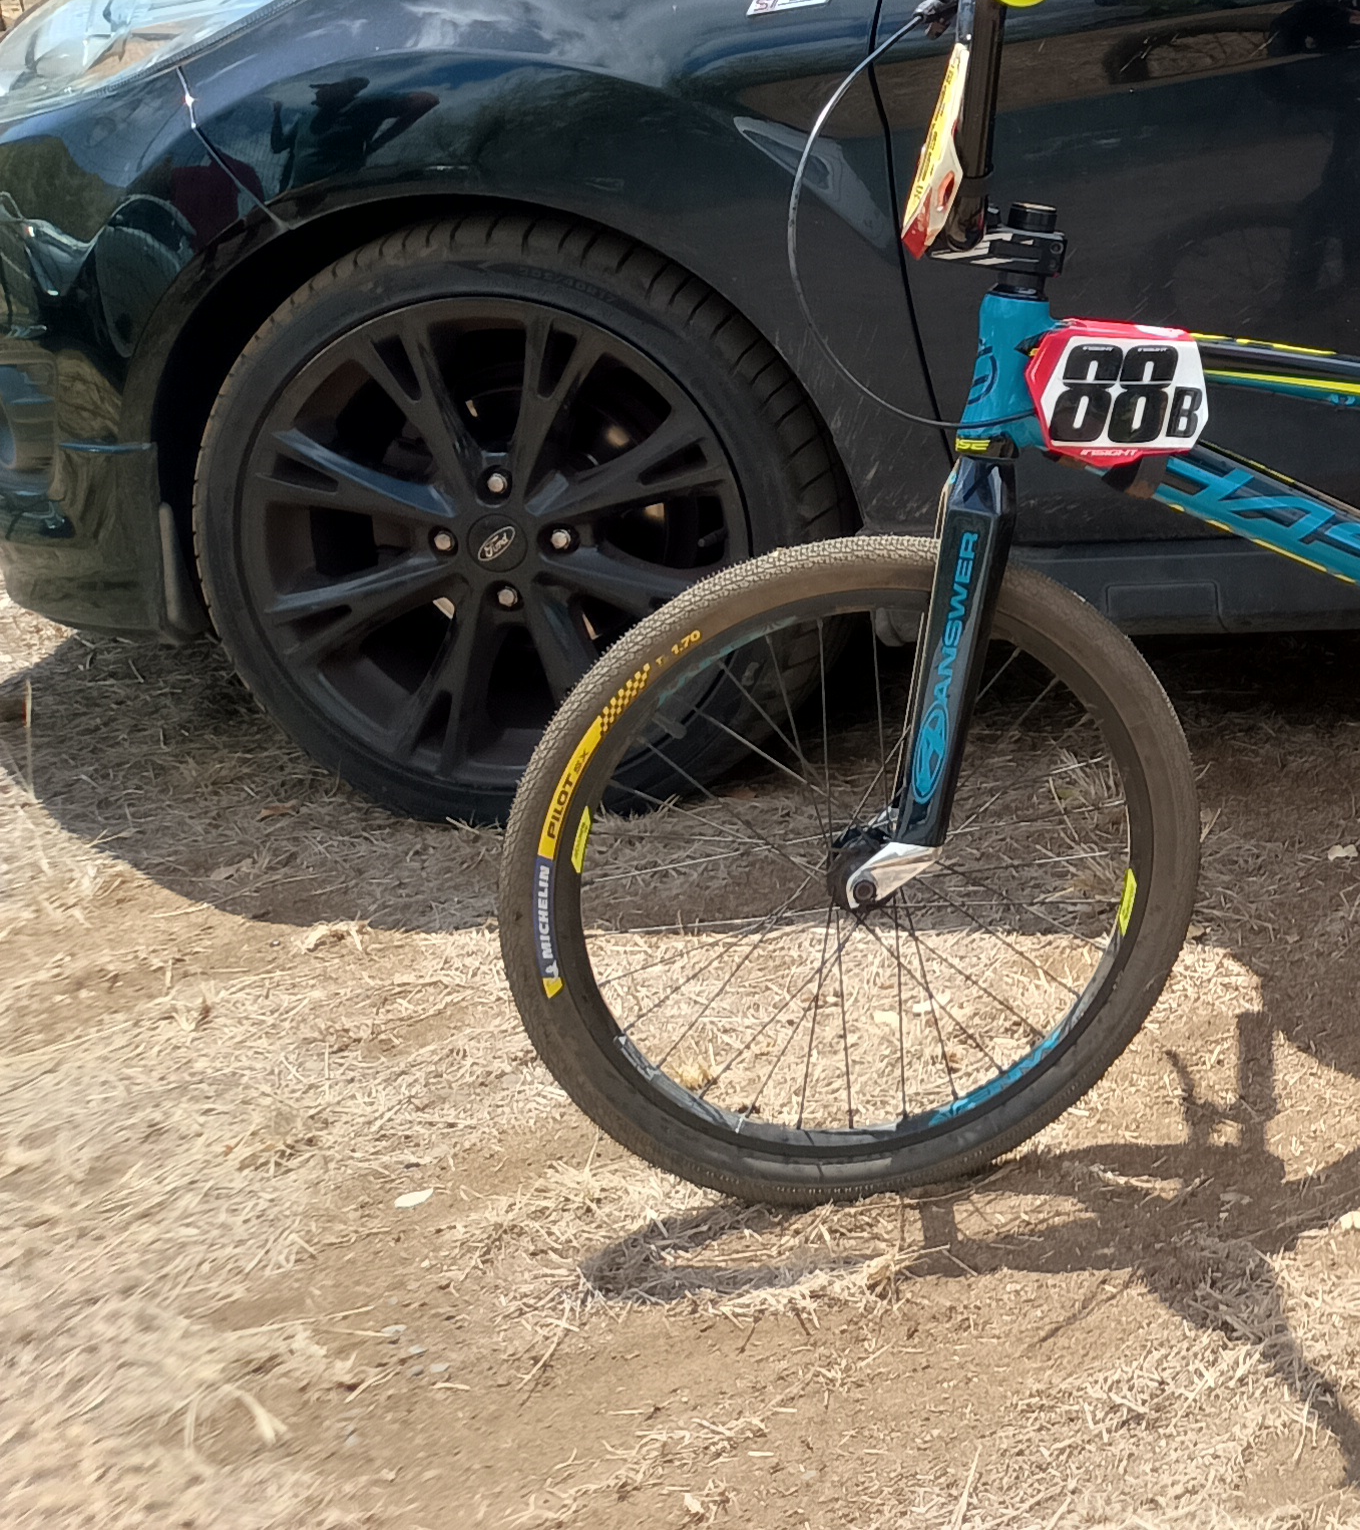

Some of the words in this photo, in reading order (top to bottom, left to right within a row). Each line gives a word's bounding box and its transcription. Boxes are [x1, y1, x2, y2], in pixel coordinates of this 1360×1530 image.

[483, 531, 510, 558] Ford
[671, 629, 701, 656] 1.70
[933, 530, 979, 704] ANSWER
[538, 864, 552, 960] MICHELIN
[546, 771, 575, 841] PILOT
